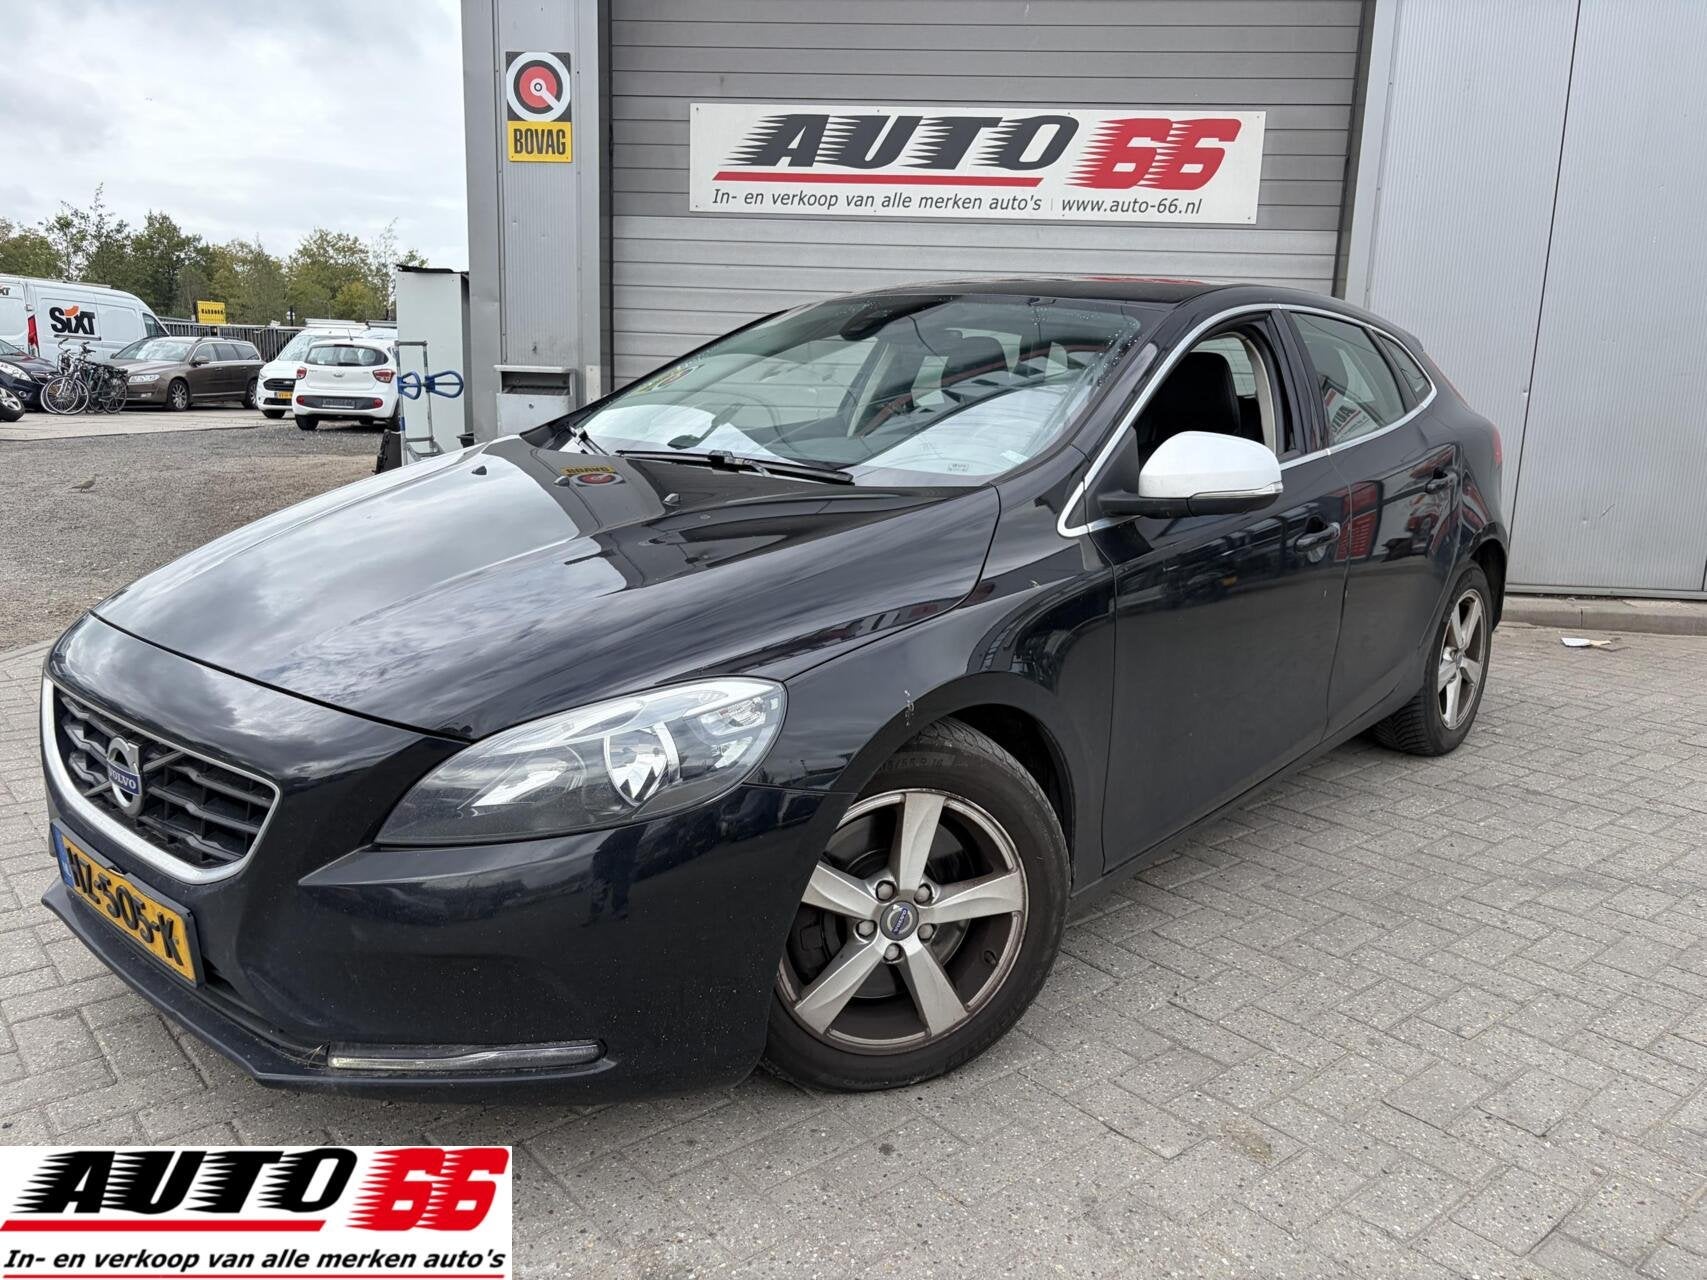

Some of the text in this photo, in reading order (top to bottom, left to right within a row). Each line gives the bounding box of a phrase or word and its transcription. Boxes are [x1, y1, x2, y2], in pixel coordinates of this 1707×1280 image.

[513, 128, 566, 155] BOVAG
[720, 113, 1242, 191] AUTO 66
[712, 188, 1203, 215] In- en verkoop van alle merken auto's www.auto-66.nl
